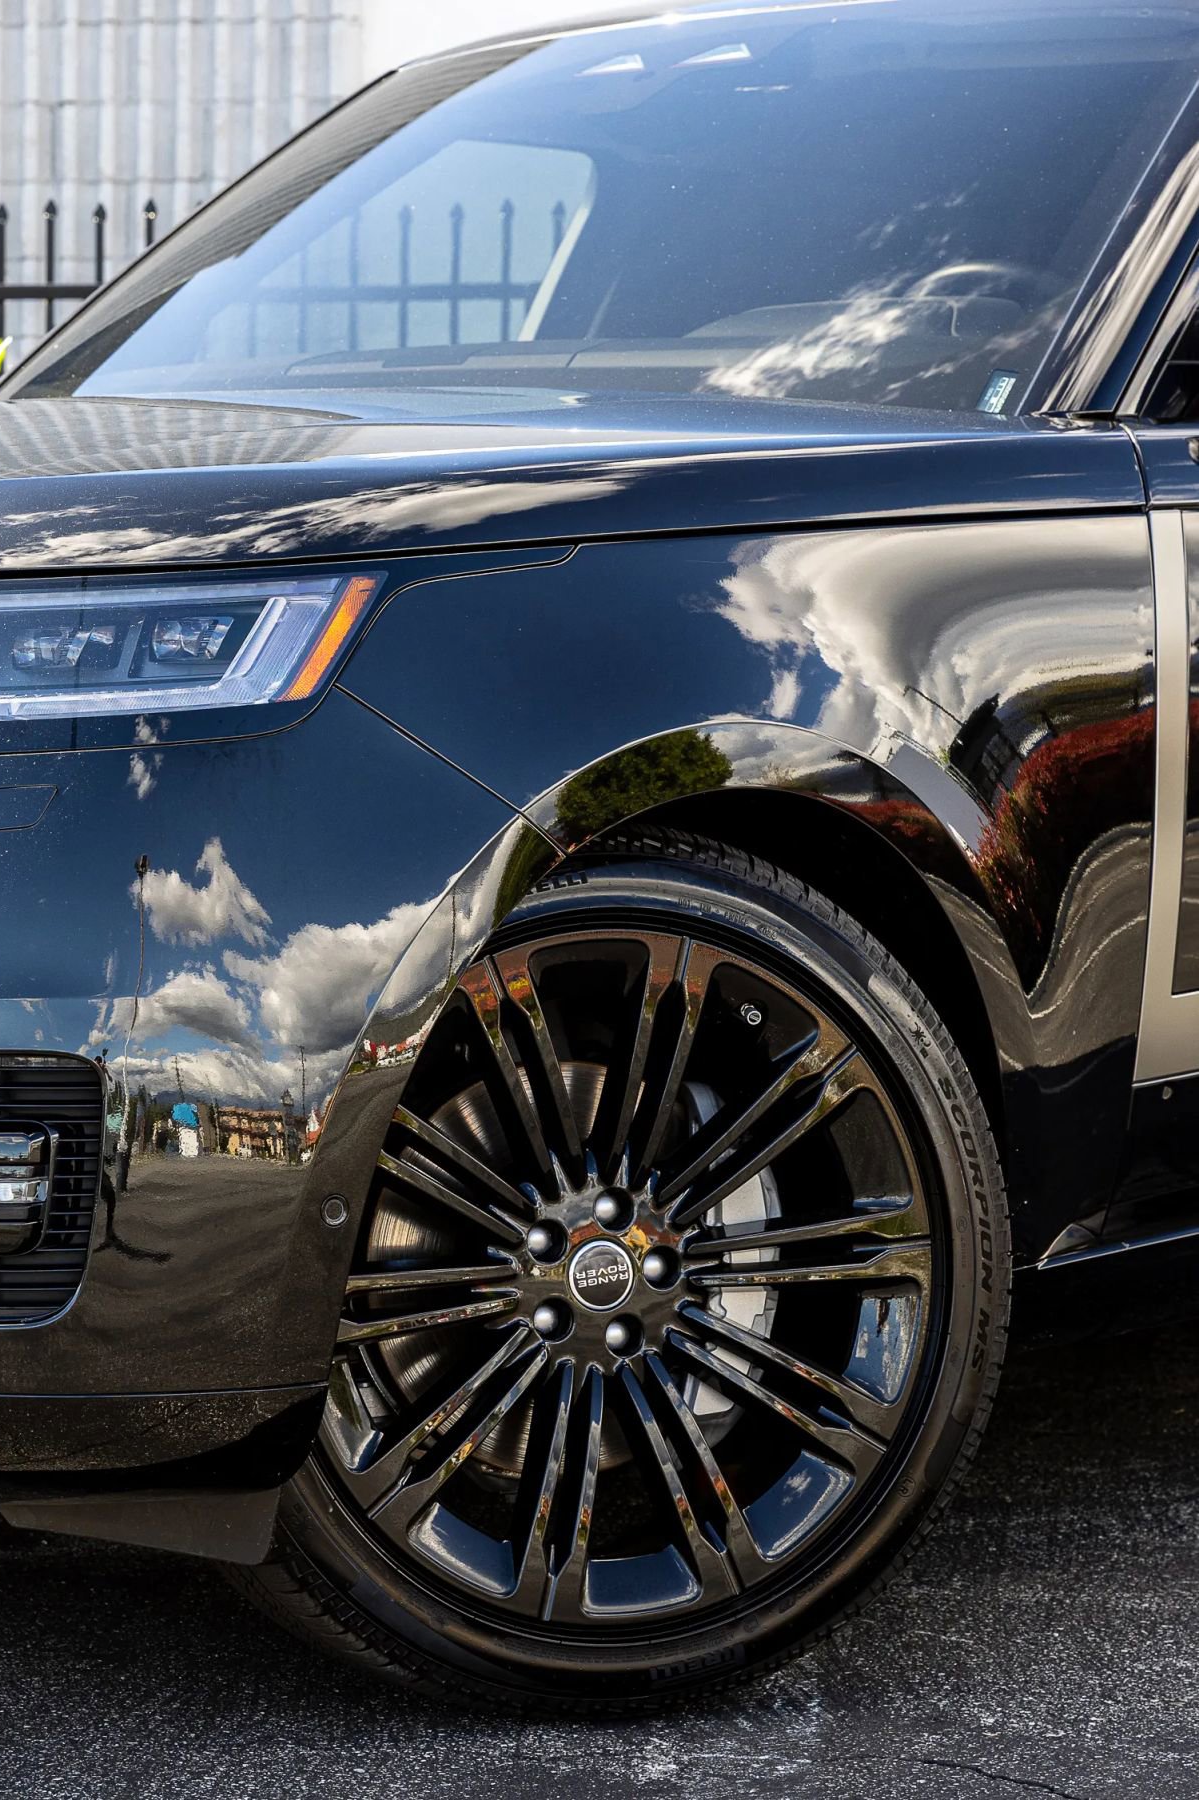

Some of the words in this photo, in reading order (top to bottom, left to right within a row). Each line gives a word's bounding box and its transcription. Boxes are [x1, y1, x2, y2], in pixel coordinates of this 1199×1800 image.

[937, 1076, 994, 1295] SCORPION
[969, 1308, 991, 1375] MS
[575, 1263, 628, 1280] ROVER
[577, 1271, 629, 1288] RANGE
